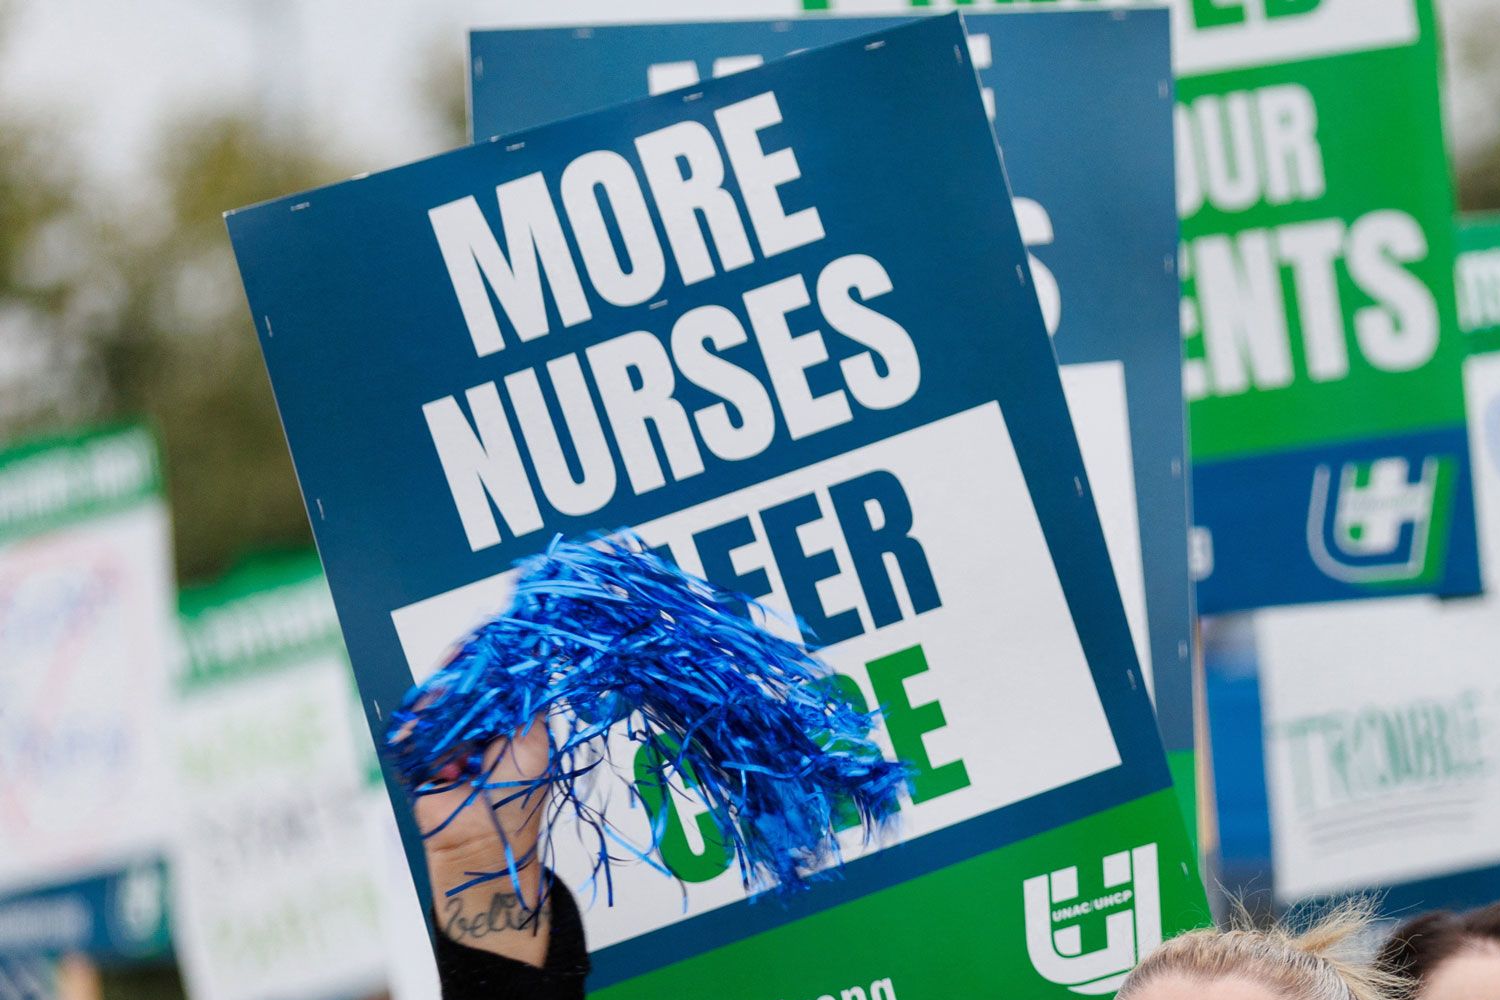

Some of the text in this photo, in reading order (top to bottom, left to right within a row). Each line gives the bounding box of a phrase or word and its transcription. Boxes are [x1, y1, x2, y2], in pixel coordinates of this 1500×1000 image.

[428, 91, 825, 357] MORE
[422, 254, 920, 552] NURSES
[650, 469, 942, 653] FER
[1051, 889, 1133, 923] UNAC/UHCP
